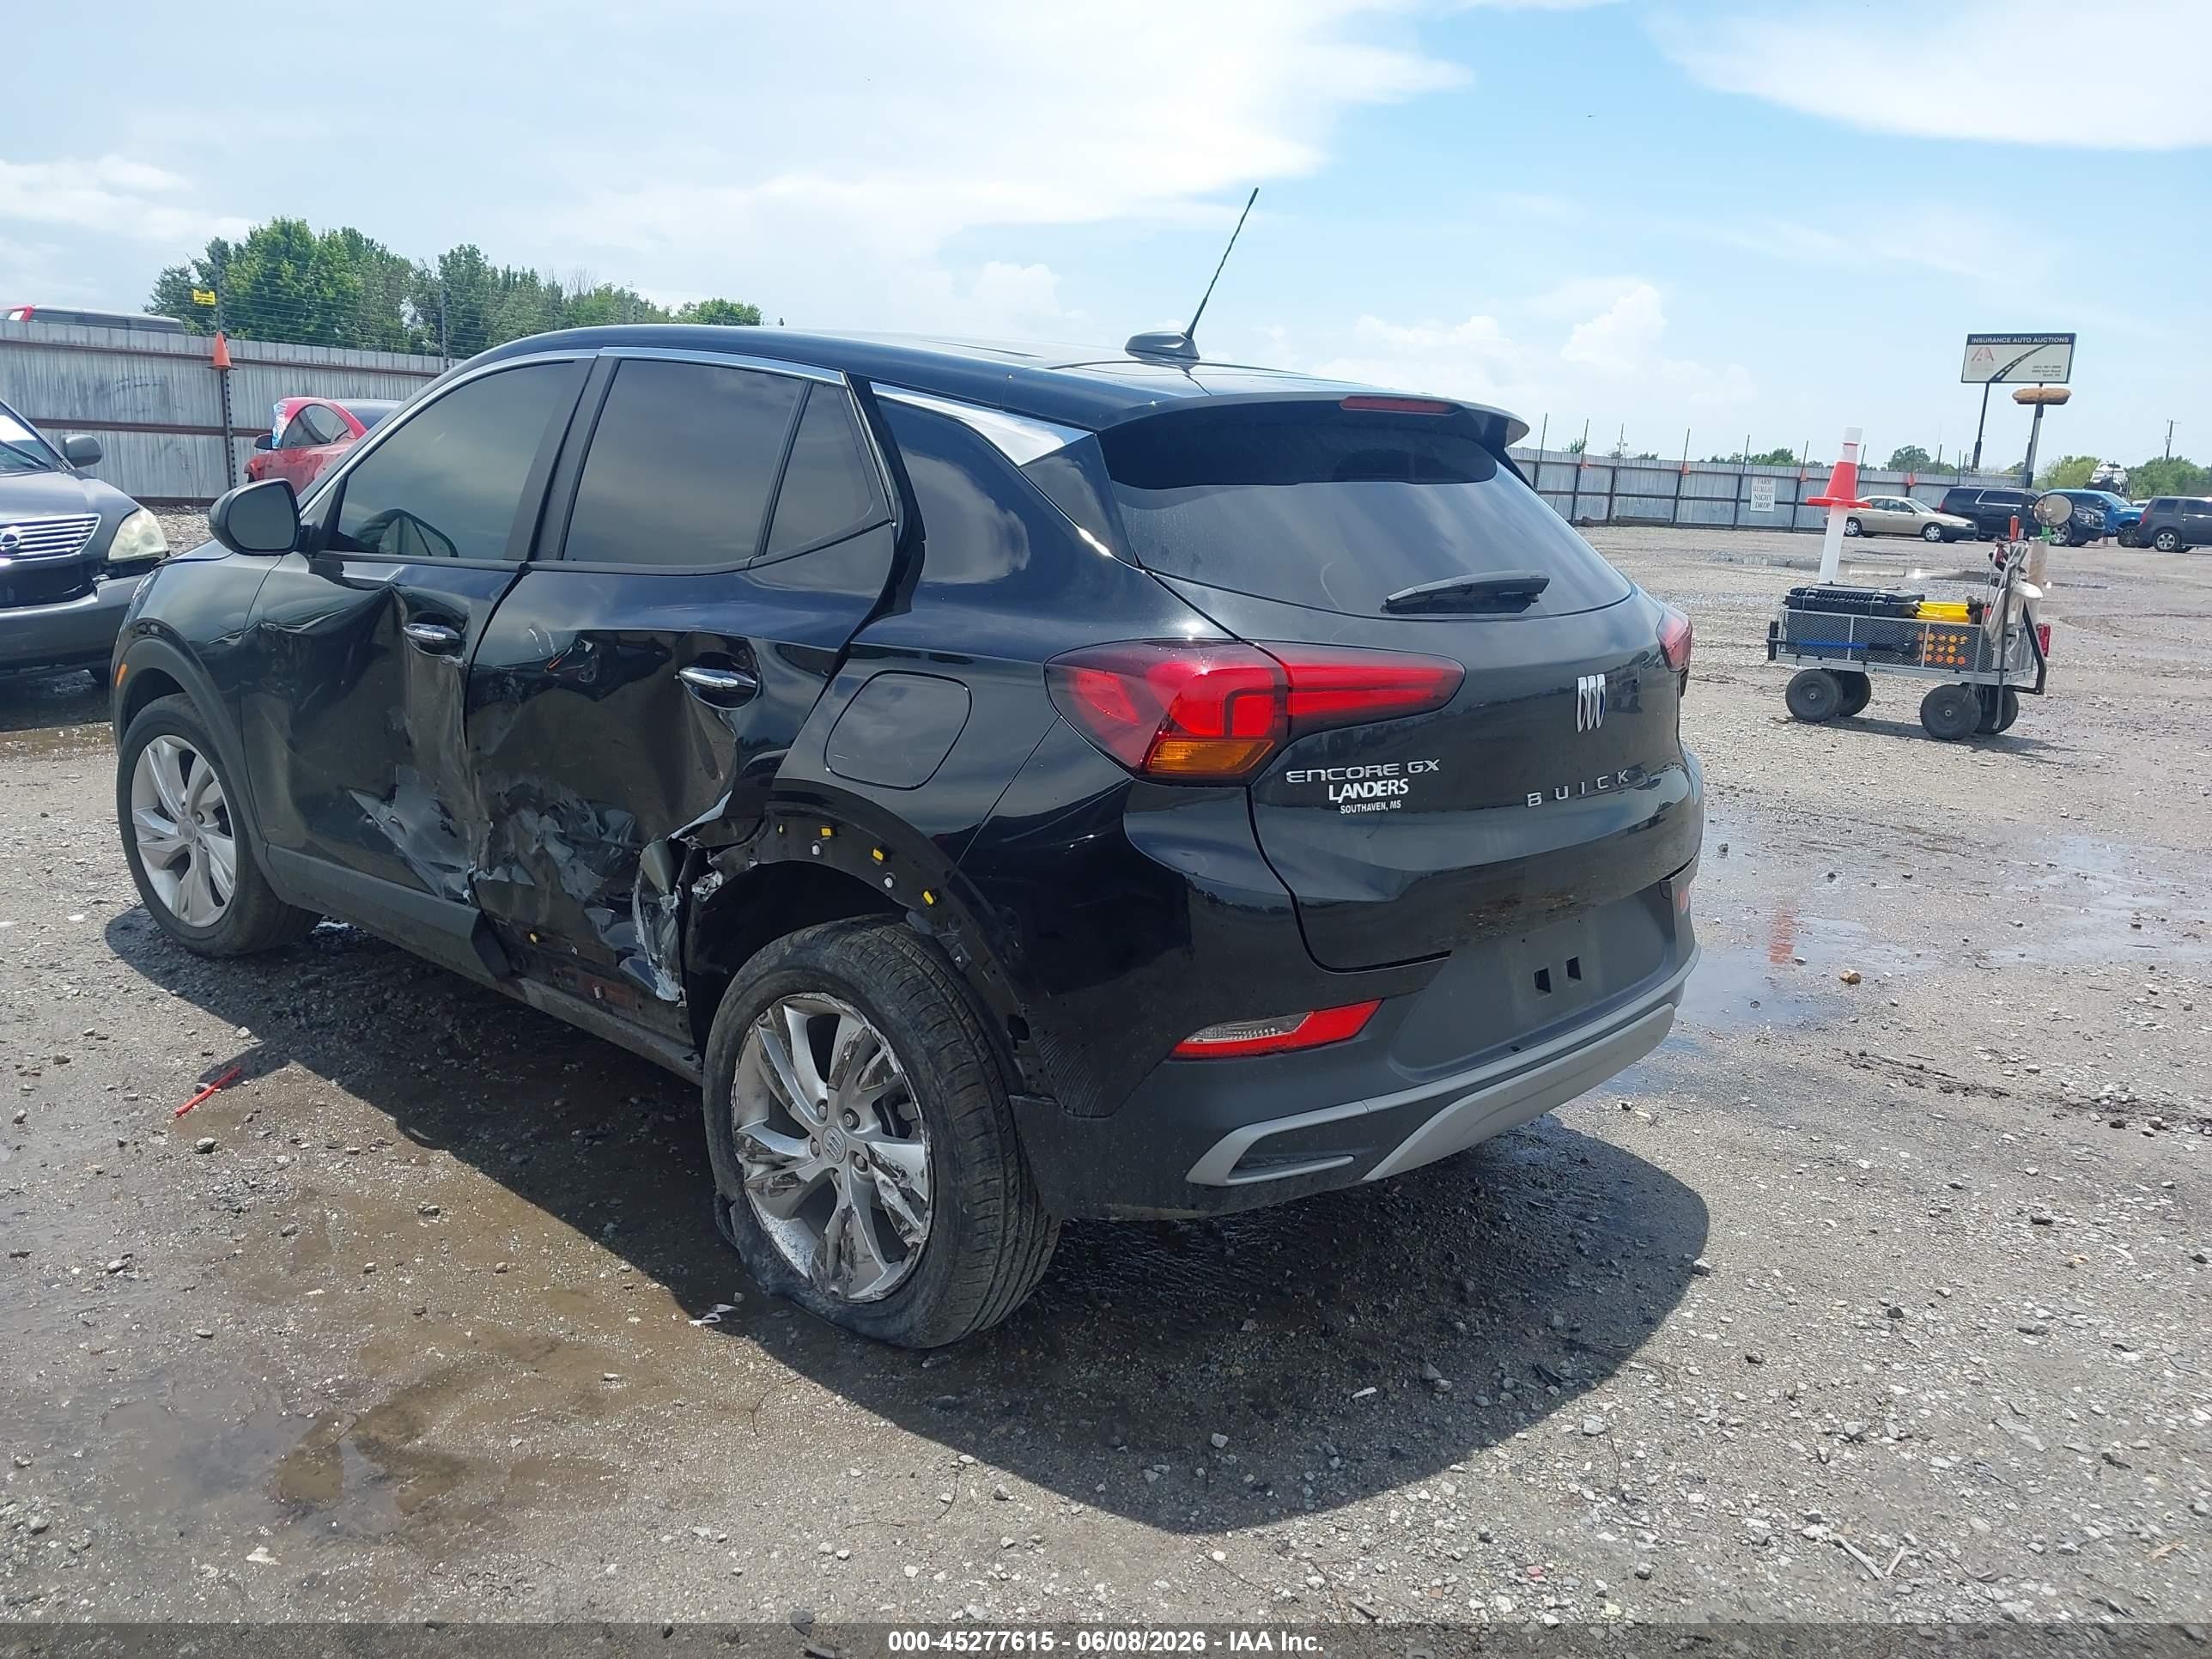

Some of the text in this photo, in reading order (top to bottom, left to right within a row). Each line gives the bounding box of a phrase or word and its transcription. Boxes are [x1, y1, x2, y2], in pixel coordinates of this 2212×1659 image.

[1285, 758, 1441, 784] ENCORE GX
[1328, 778, 1409, 804] LANDERS
[1526, 769, 1630, 808] BUICK
[1340, 799, 1401, 815] SOUTHAVEN, MS
